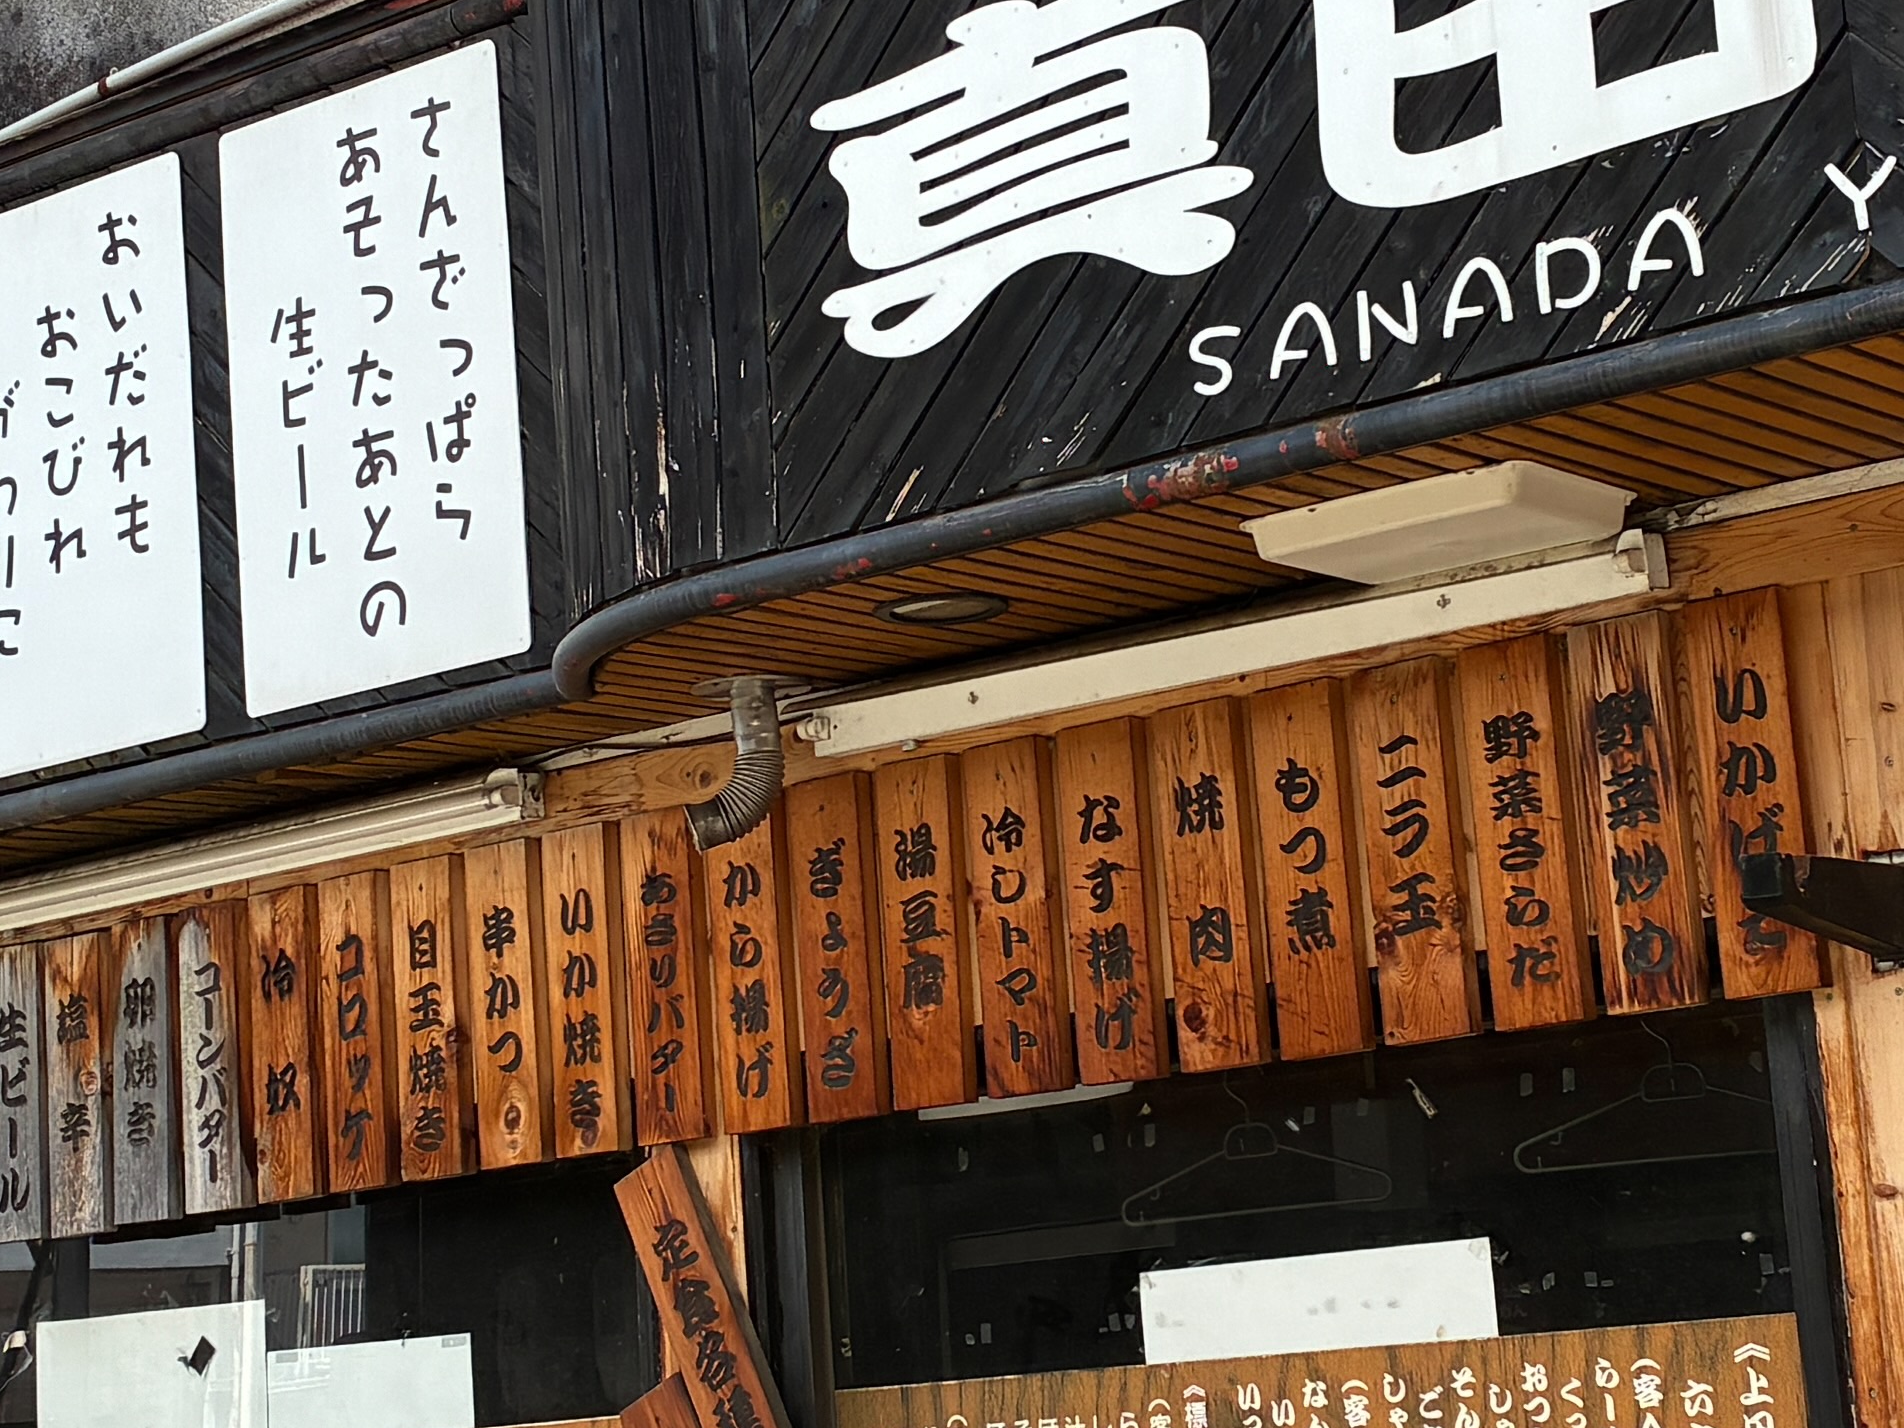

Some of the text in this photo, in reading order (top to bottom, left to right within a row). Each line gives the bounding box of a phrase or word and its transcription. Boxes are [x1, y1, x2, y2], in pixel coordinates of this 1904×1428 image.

[99, 211, 153, 558] おいだれも
[336, 127, 408, 635] あそったあとの
[1188, 207, 1707, 397] SANADA
[37, 304, 89, 575] おこびれ
[269, 297, 328, 580] 生ビール
[895, 823, 950, 1009] 湯豆腐
[982, 807, 1038, 1062] 冷しトマト
[1077, 795, 1140, 1050] なす揚げ
[1174, 772, 1234, 967] 焼肉
[1275, 757, 1336, 954] もつ煮
[1377, 735, 1442, 936] ニラ玉
[1482, 711, 1560, 988] 野菜さらだ
[1596, 689, 1674, 978] 野菜炒め
[56, 993, 90, 1153] 塩辛
[124, 977, 157, 1146] 卵焼き
[194, 963, 227, 1183] コーンバター
[261, 948, 301, 1116] 冷奴
[336, 934, 373, 1160] コロッケ
[408, 919, 447, 1153] 目玉焼き
[483, 906, 522, 1073] 串かつ
[561, 887, 602, 1135] いか焼き
[640, 873, 684, 1113] あさりバター
[723, 861, 773, 1098] から揚げ
[809, 838, 859, 1088] ぎょうざ
